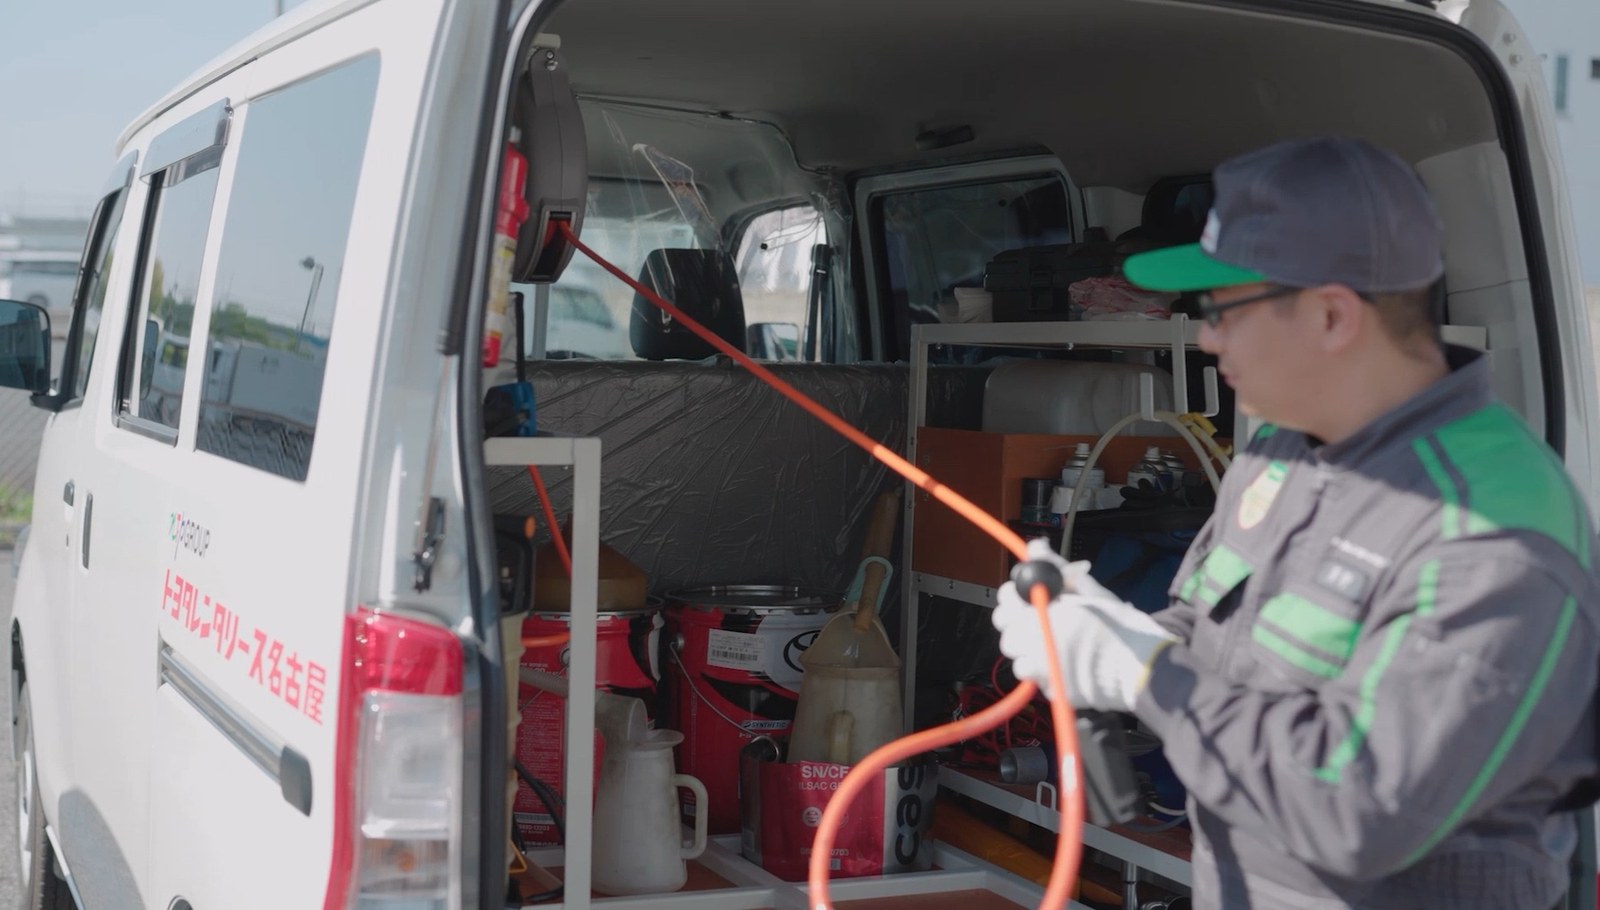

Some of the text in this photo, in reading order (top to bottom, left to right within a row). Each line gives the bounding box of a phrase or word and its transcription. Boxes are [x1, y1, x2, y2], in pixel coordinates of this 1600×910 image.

[184, 519, 210, 558] GROUP
[162, 568, 327, 725] トヨタレンタリース名古屋
[751, 720, 787, 728] SYNTHETIC
[802, 764, 849, 779] SN/CF
[799, 781, 828, 790] ILSAC
